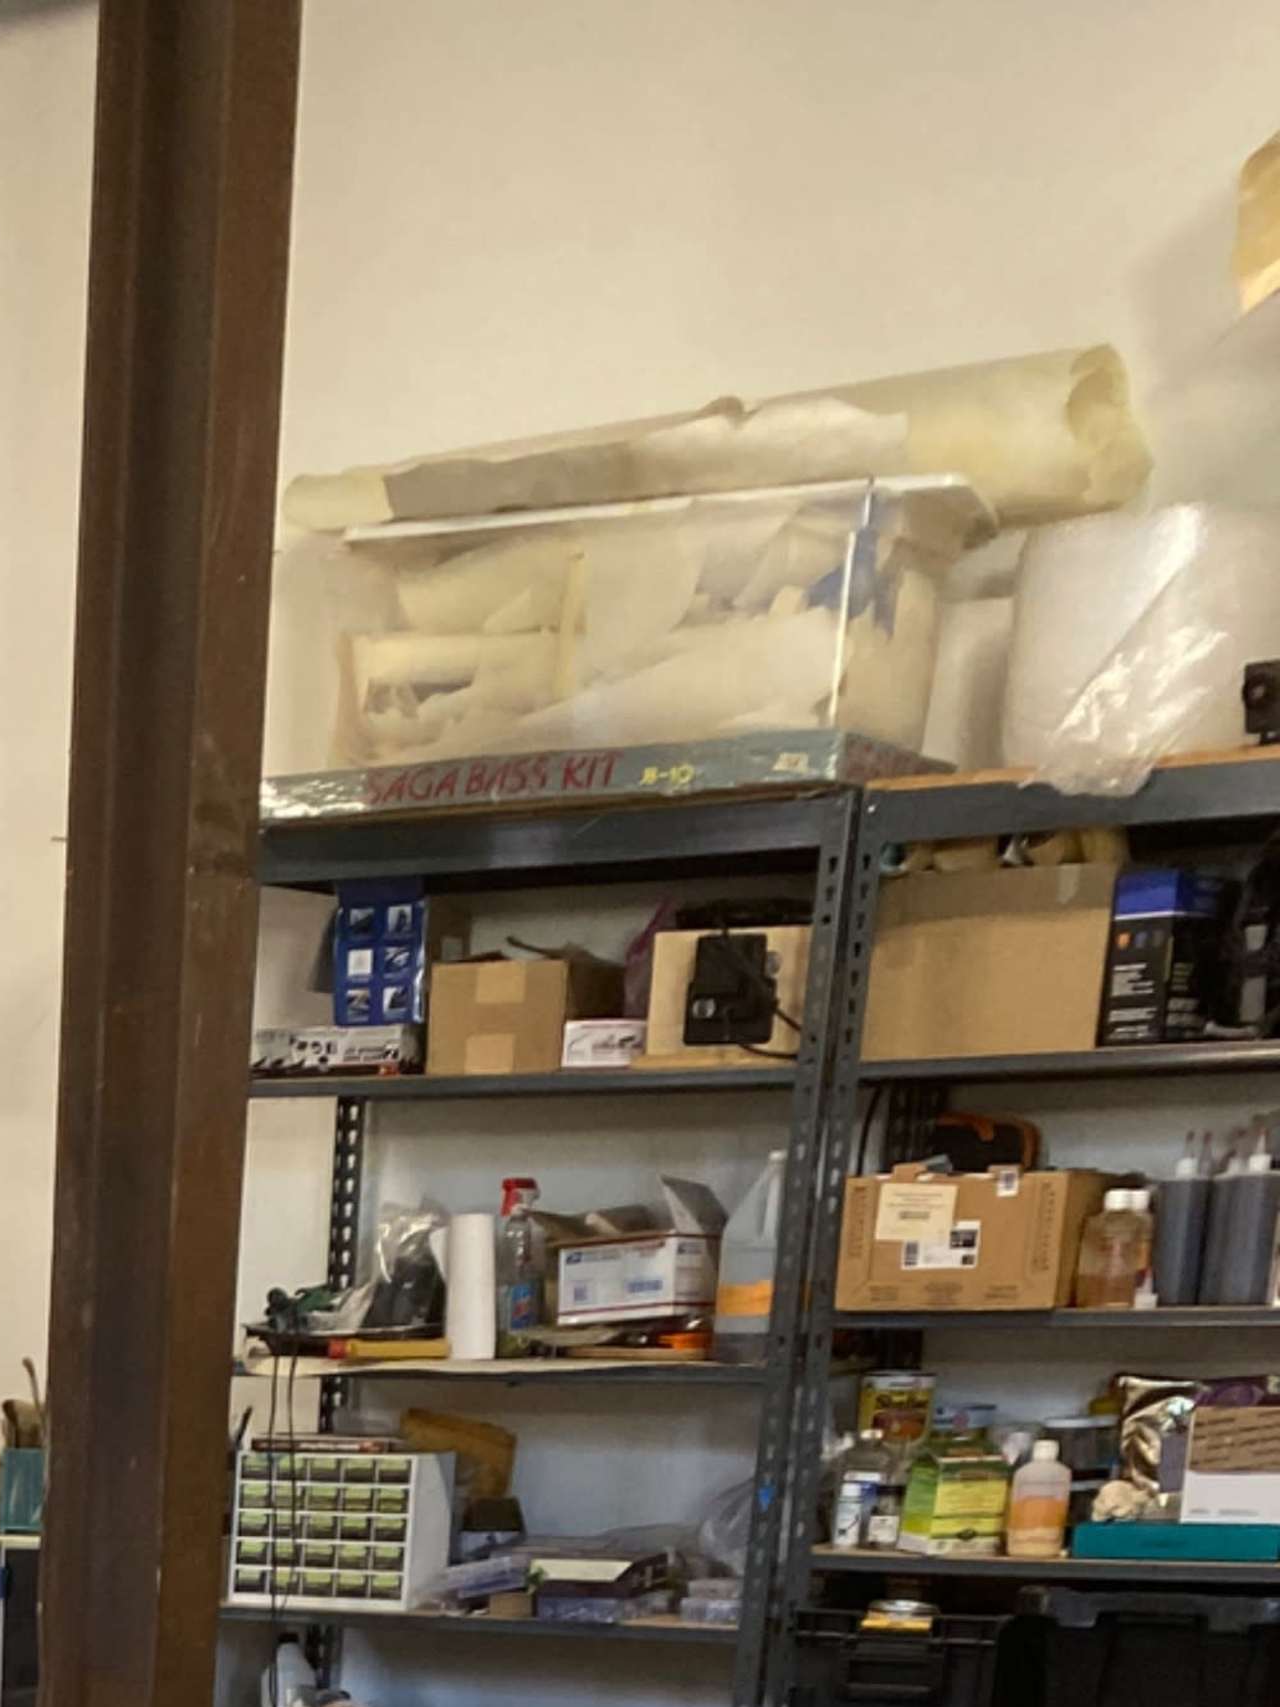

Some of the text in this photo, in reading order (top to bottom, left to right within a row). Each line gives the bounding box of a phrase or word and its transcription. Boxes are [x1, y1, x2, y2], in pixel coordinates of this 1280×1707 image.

[366, 750, 622, 805] SAGA BASS KIT
